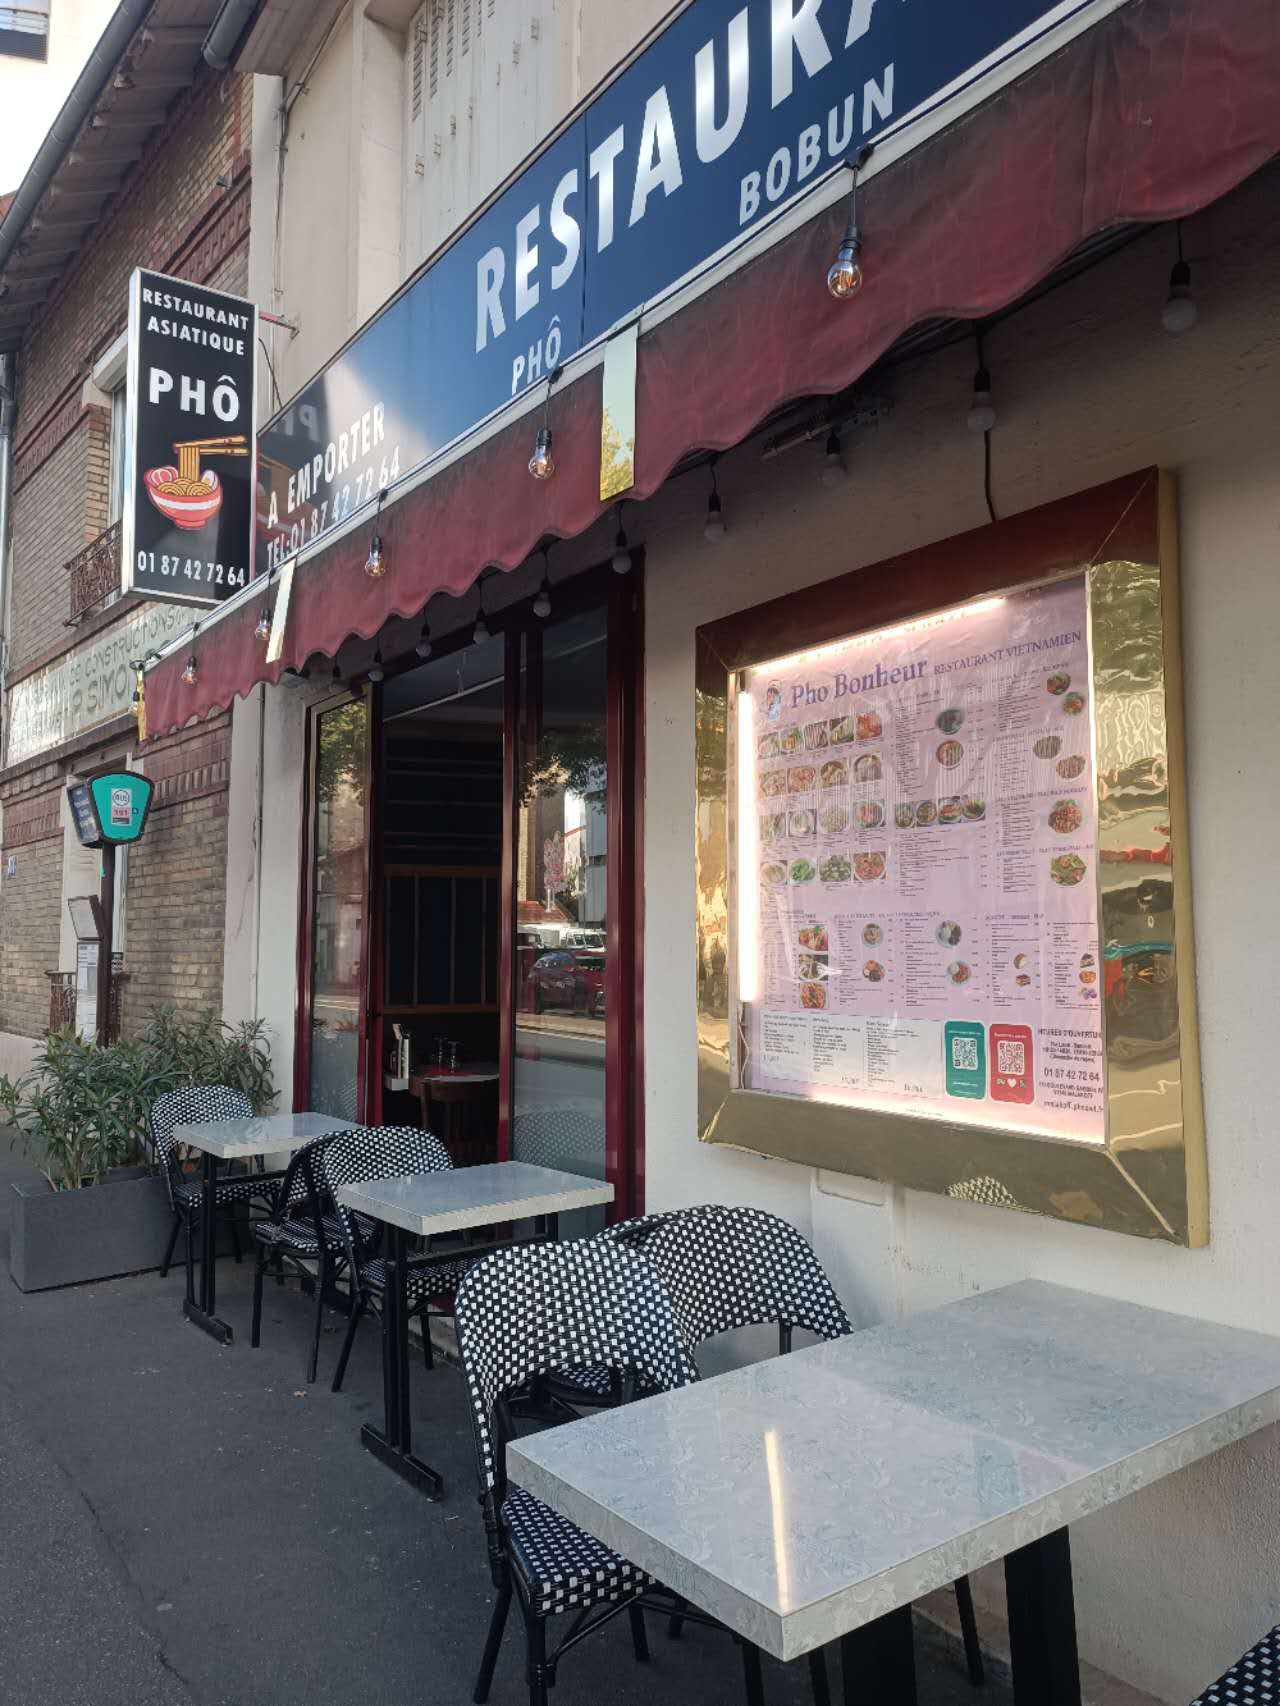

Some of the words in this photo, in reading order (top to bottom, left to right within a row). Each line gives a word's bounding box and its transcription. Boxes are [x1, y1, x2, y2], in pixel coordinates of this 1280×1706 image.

[739, 63, 895, 226] BOBUN
[142, 287, 249, 330] RESTAURANT
[147, 315, 245, 356] ASIATIQUE
[511, 314, 562, 396] PHÔ
[149, 366, 240, 422] PHÔ
[287, 401, 385, 514] EMPORTER
[379, 446, 400, 490] 64
[137, 550, 155, 573] 01
[161, 555, 180, 577] 87
[183, 558, 202, 580] 42
[207, 562, 223, 584] 72
[227, 566, 245, 587] 64
[791, 681, 829, 708] Pho
[834, 660, 927, 698] Bonheur
[934, 650, 1002, 675] RESTAURANT
[1006, 631, 1081, 657] VIETNAMIEN
[1044, 1067, 1053, 1077] 01
[1066, 1069, 1077, 1080] 42
[1078, 1070, 1088, 1081] 72
[1089, 1071, 1100, 1082] 64
